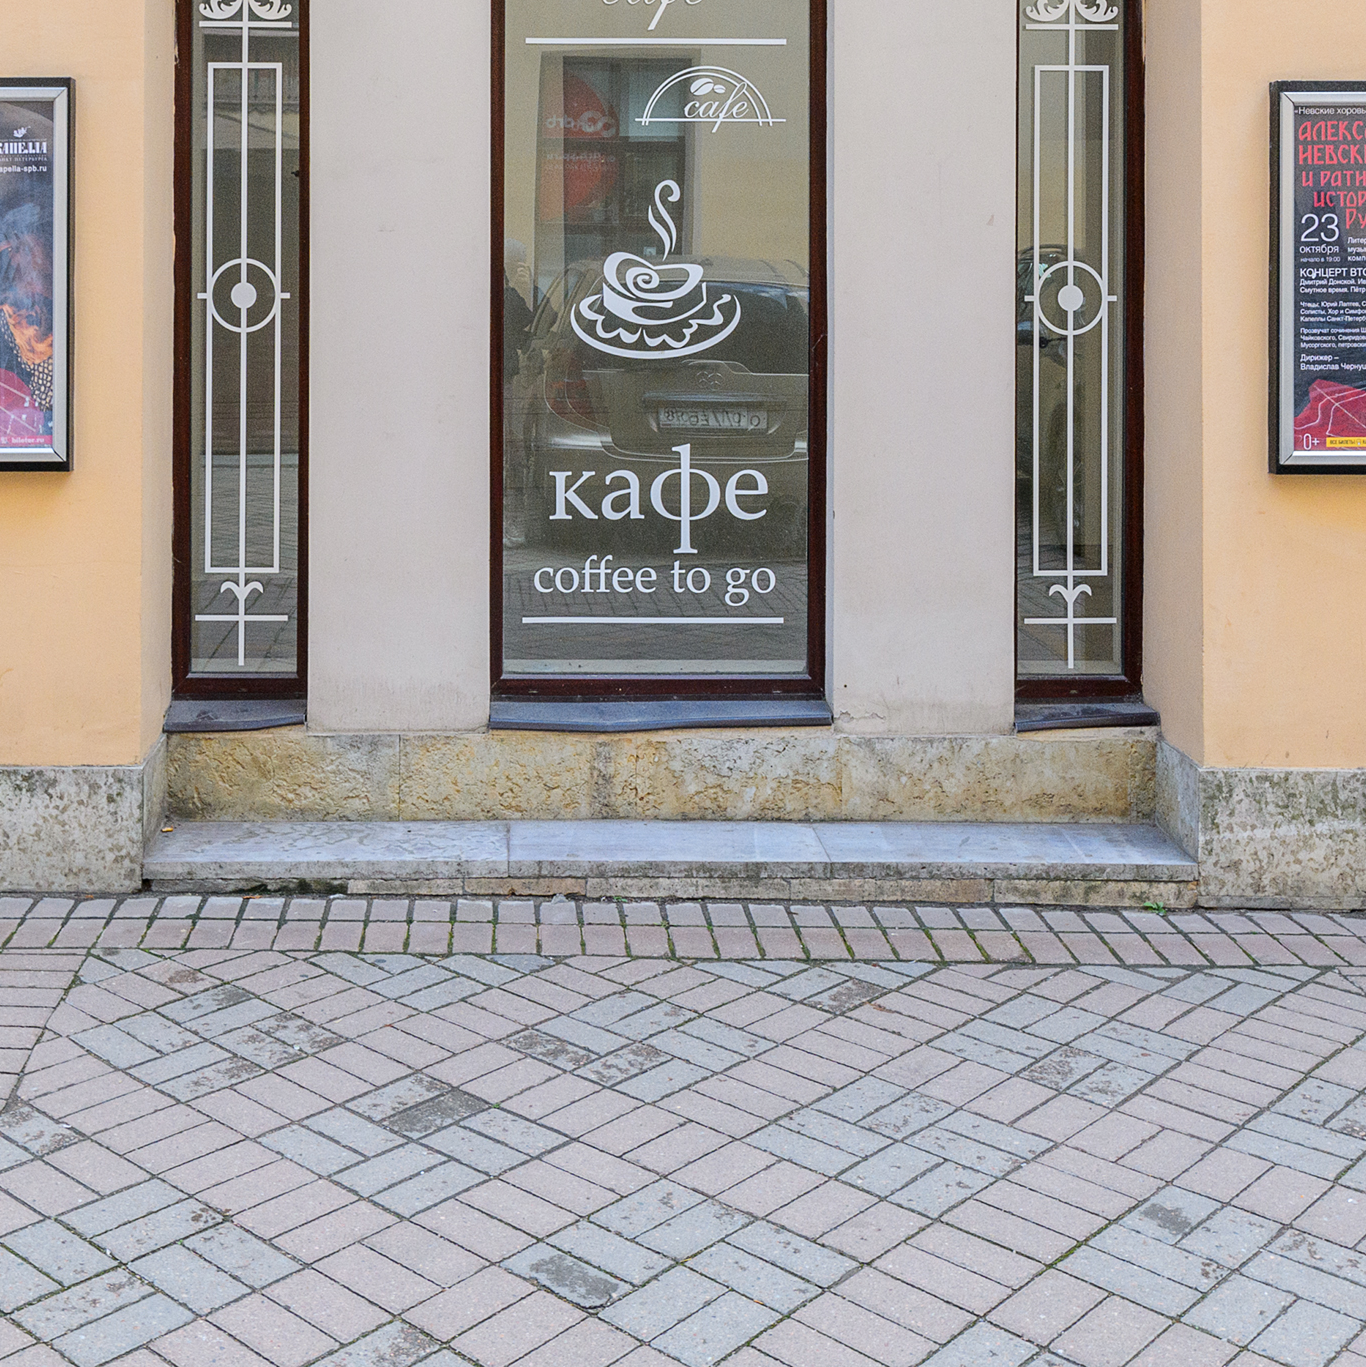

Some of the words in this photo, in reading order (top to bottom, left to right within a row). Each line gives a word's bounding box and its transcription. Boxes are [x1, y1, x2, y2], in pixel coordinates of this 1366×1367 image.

[684, 82, 749, 133] cafe
[1301, 213, 1339, 242] 23
[1300, 244, 1339, 255] октября
[1300, 268, 1348, 278] КОНЦЕРТ
[1300, 363, 1339, 371] Владислав
[1303, 433, 1319, 450] 0+
[549, 443, 768, 554] кафе
[534, 555, 657, 594] coffee
[671, 561, 710, 594] to
[725, 567, 776, 607] go
